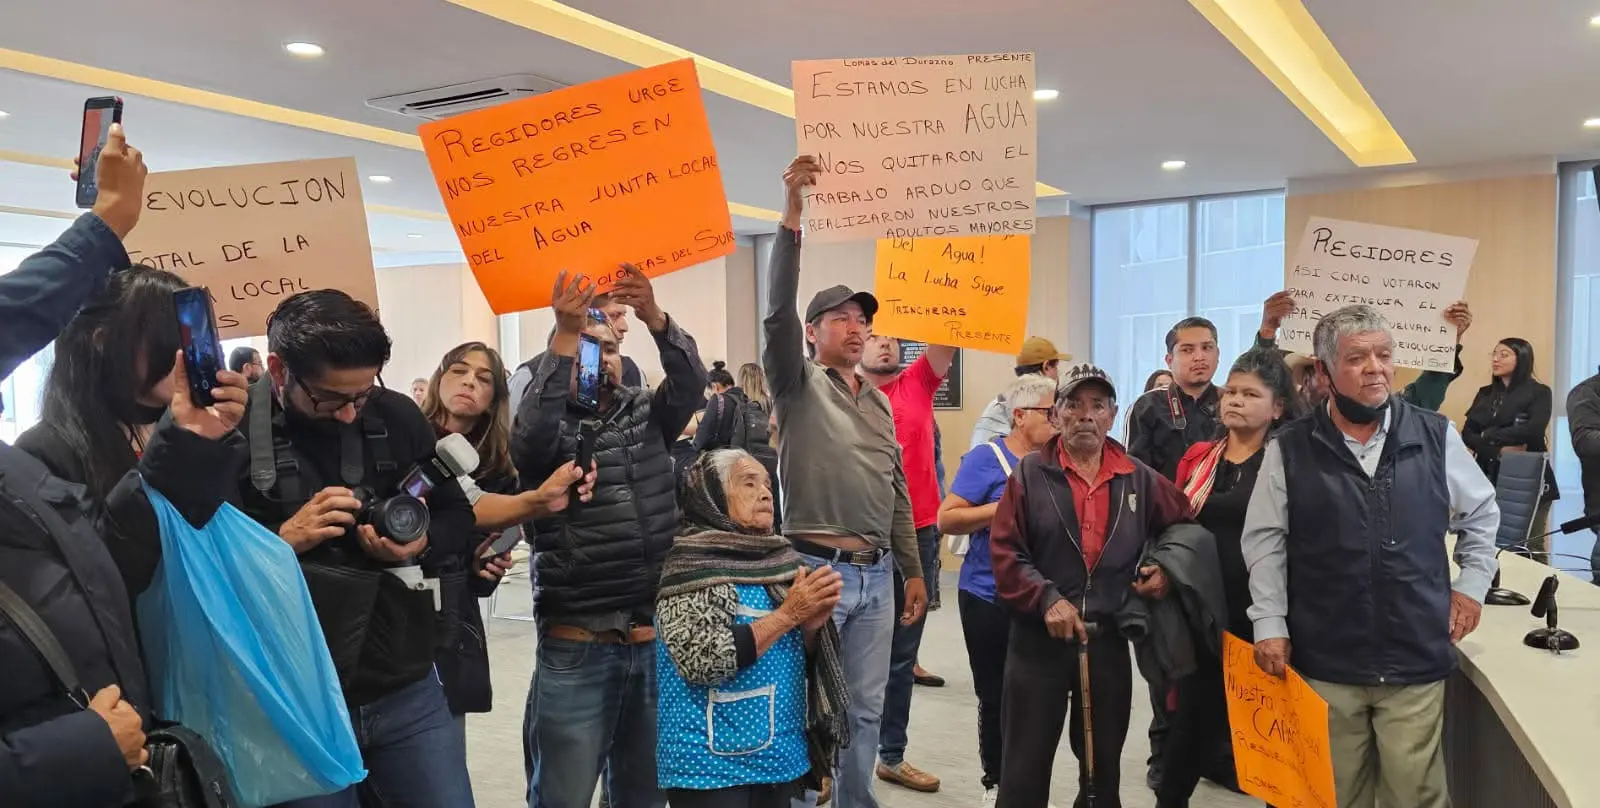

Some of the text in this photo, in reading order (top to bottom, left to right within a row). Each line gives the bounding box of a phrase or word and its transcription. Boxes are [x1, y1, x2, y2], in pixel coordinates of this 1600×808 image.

[843, 53, 1032, 67] Lomas del Durazno PRESENTE
[811, 71, 1028, 99] ESTAMOS EN LUCHA
[434, 78, 685, 163] REGIDORES URGE
[803, 99, 1028, 140] POR NUESTRA AGUA
[445, 113, 671, 200] NOS REGRESEN
[818, 146, 1029, 177] NOS QUITARON EL
[146, 171, 348, 210] EVOLUCION
[459, 155, 718, 239] NUESTRA JUNTA LOCAL
[804, 177, 1020, 208] TRABAJO ARDUO QUE
[808, 200, 1030, 231] REALIZARON NUESTROS
[886, 219, 1034, 240] ADULTOS MAYORES
[222, 240, 258, 262] DE
[282, 234, 310, 254] LA
[471, 220, 593, 267] DEL AGUA
[671, 248, 692, 262] DEL
[694, 228, 736, 252] SUR
[1313, 227, 1454, 267] REGIDORES
[231, 277, 311, 300] LOCAL
[888, 262, 1005, 297] La Lucha Sigue
[1294, 265, 1441, 290] ASI COMO VOTARON
[886, 299, 967, 318] TRINCHERAS
[1289, 287, 1315, 299] PARA
[1418, 301, 1437, 310] EL
[944, 320, 1013, 345] PRESENTE
